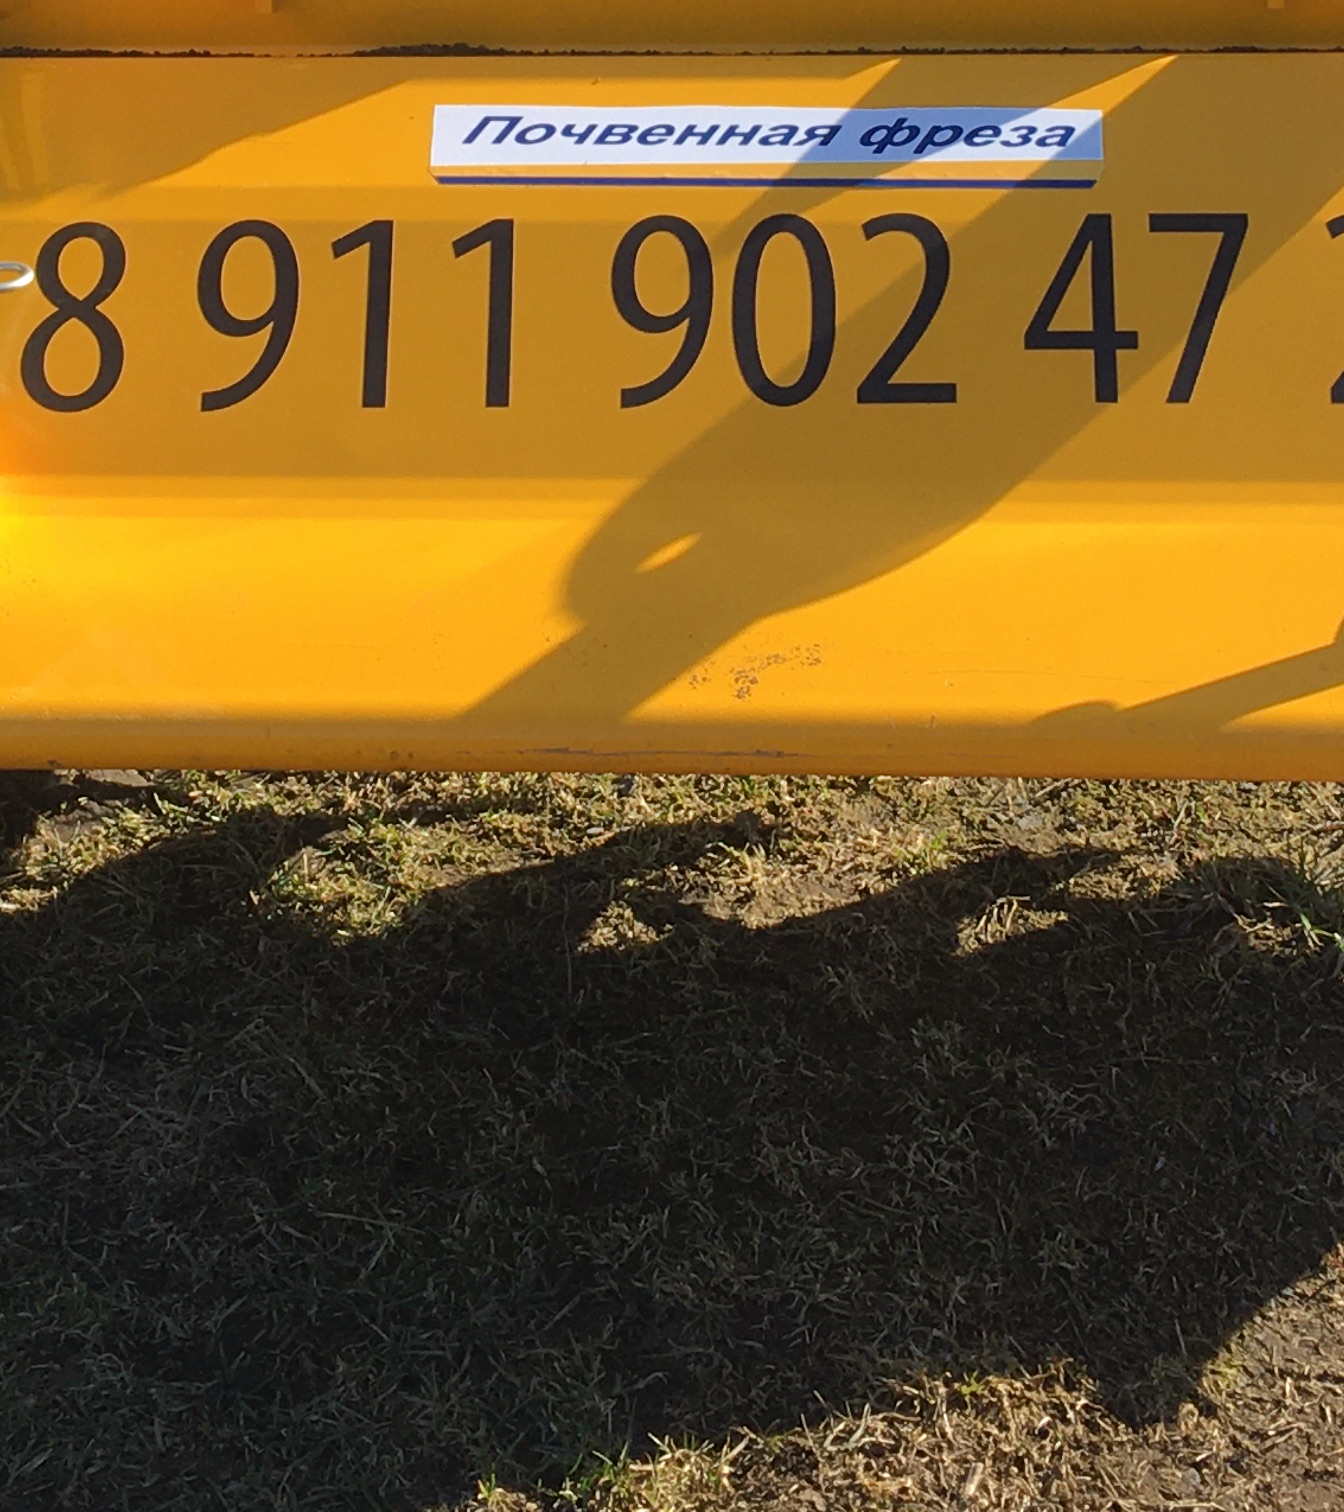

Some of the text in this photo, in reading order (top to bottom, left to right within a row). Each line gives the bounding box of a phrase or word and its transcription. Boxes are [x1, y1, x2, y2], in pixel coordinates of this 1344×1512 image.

[461, 115, 1077, 155] Почвенная фреза
[19, 221, 127, 413] 8
[197, 218, 515, 412] 911
[611, 213, 958, 409] 902
[1023, 212, 1250, 405] 47
